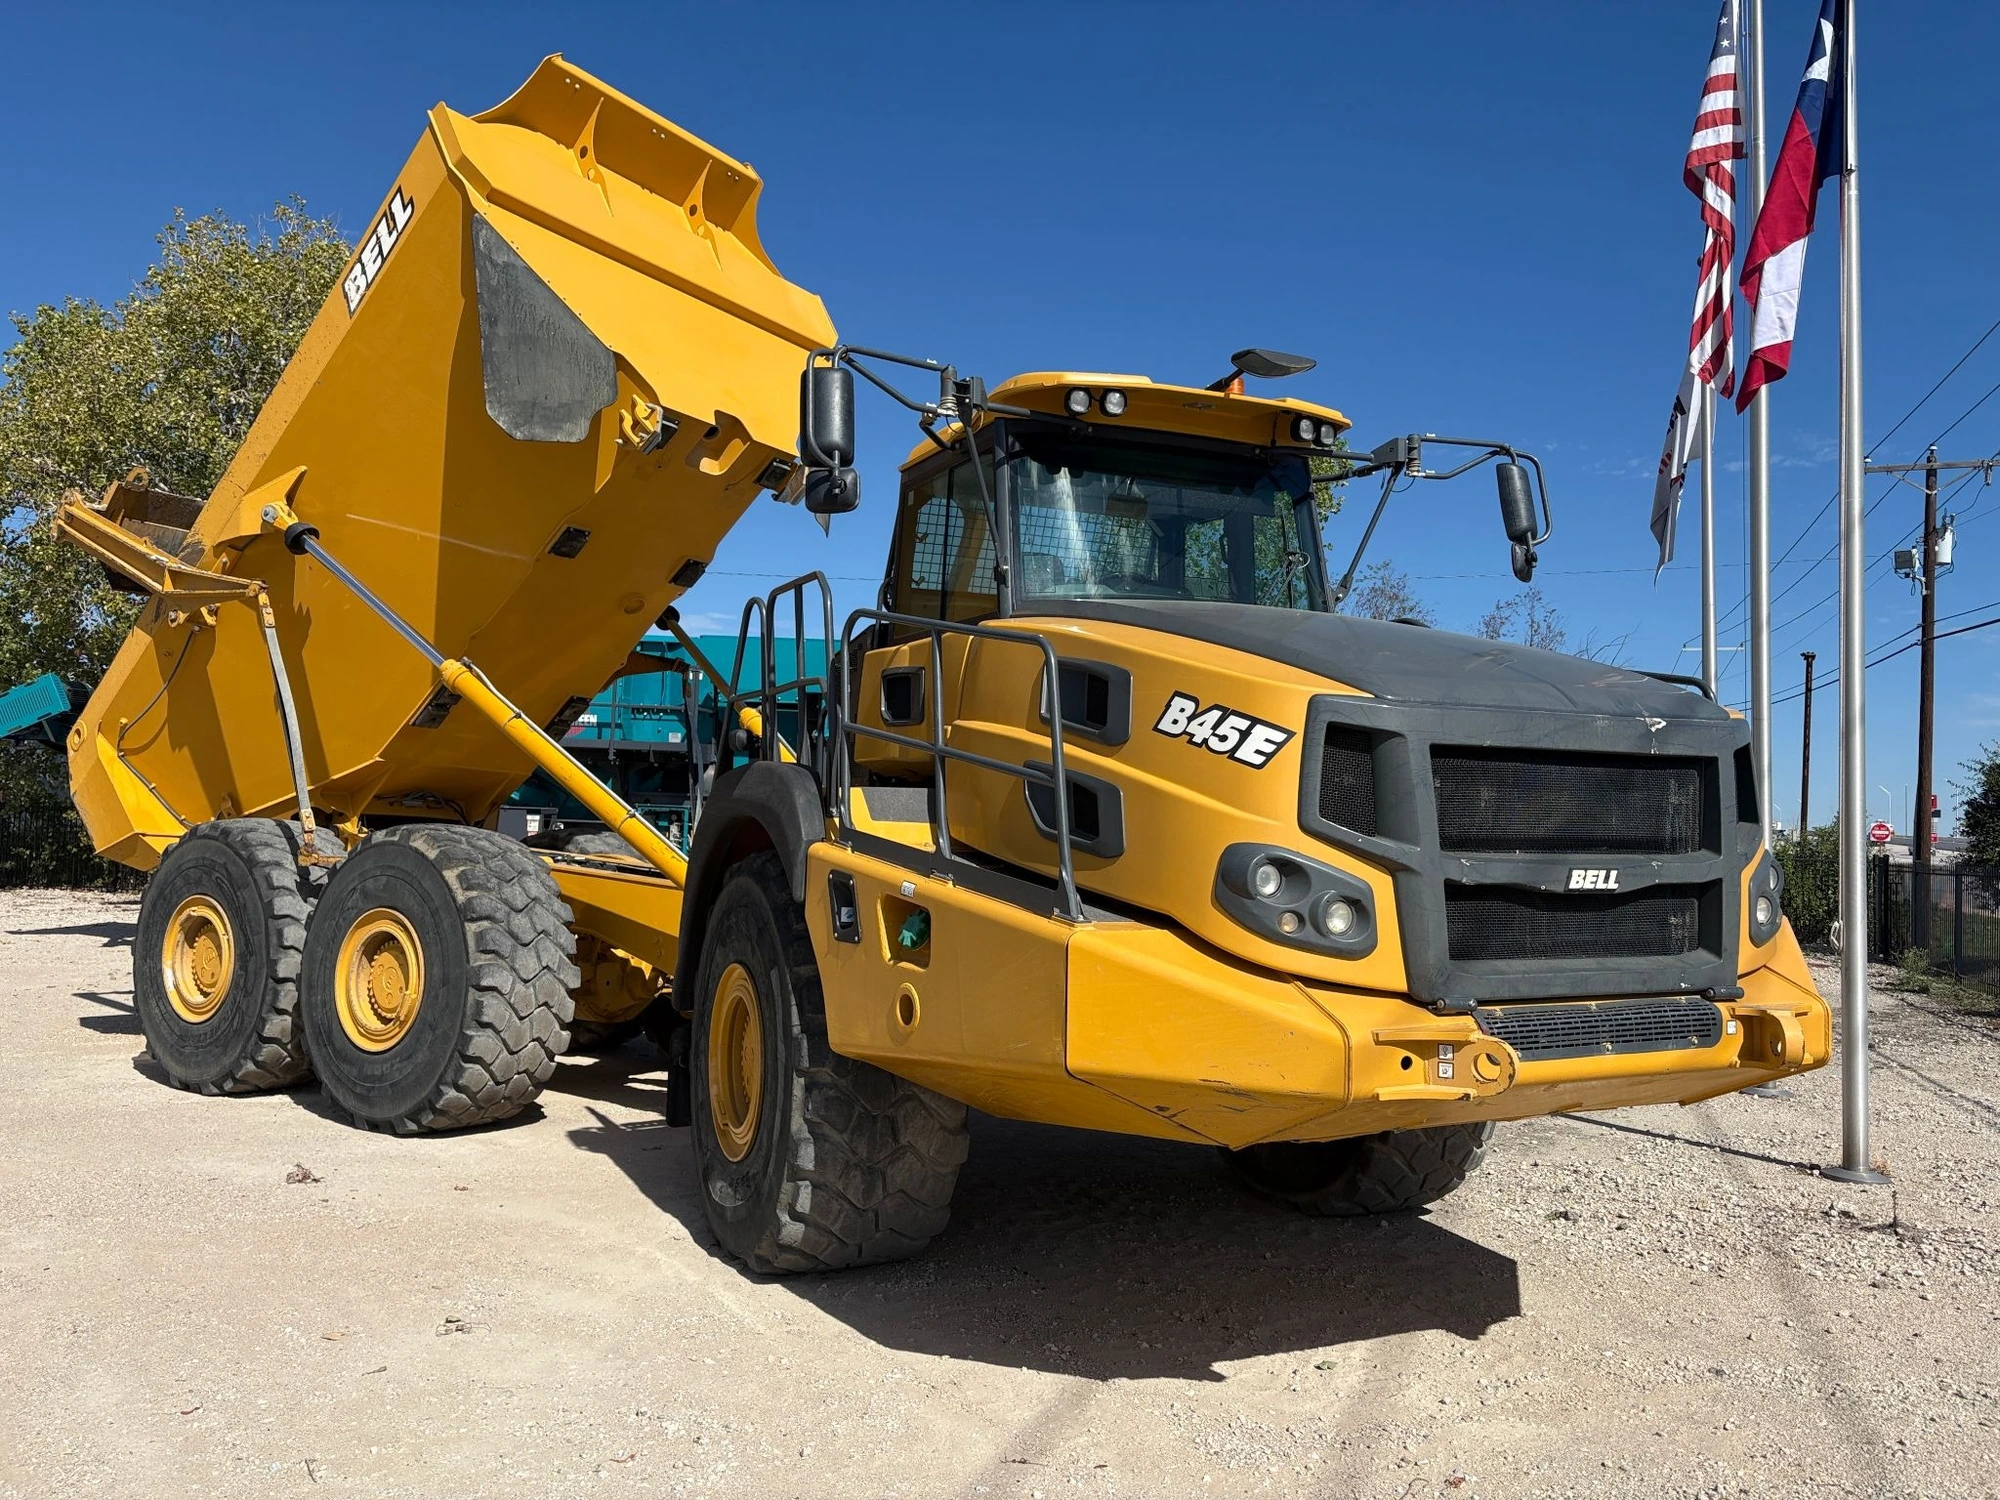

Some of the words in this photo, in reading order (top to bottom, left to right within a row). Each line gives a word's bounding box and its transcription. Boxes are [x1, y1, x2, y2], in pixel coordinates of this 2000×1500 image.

[343, 188, 413, 316] BELL
[1154, 693, 1291, 767] B45E
[1568, 869, 1619, 889] BELL
